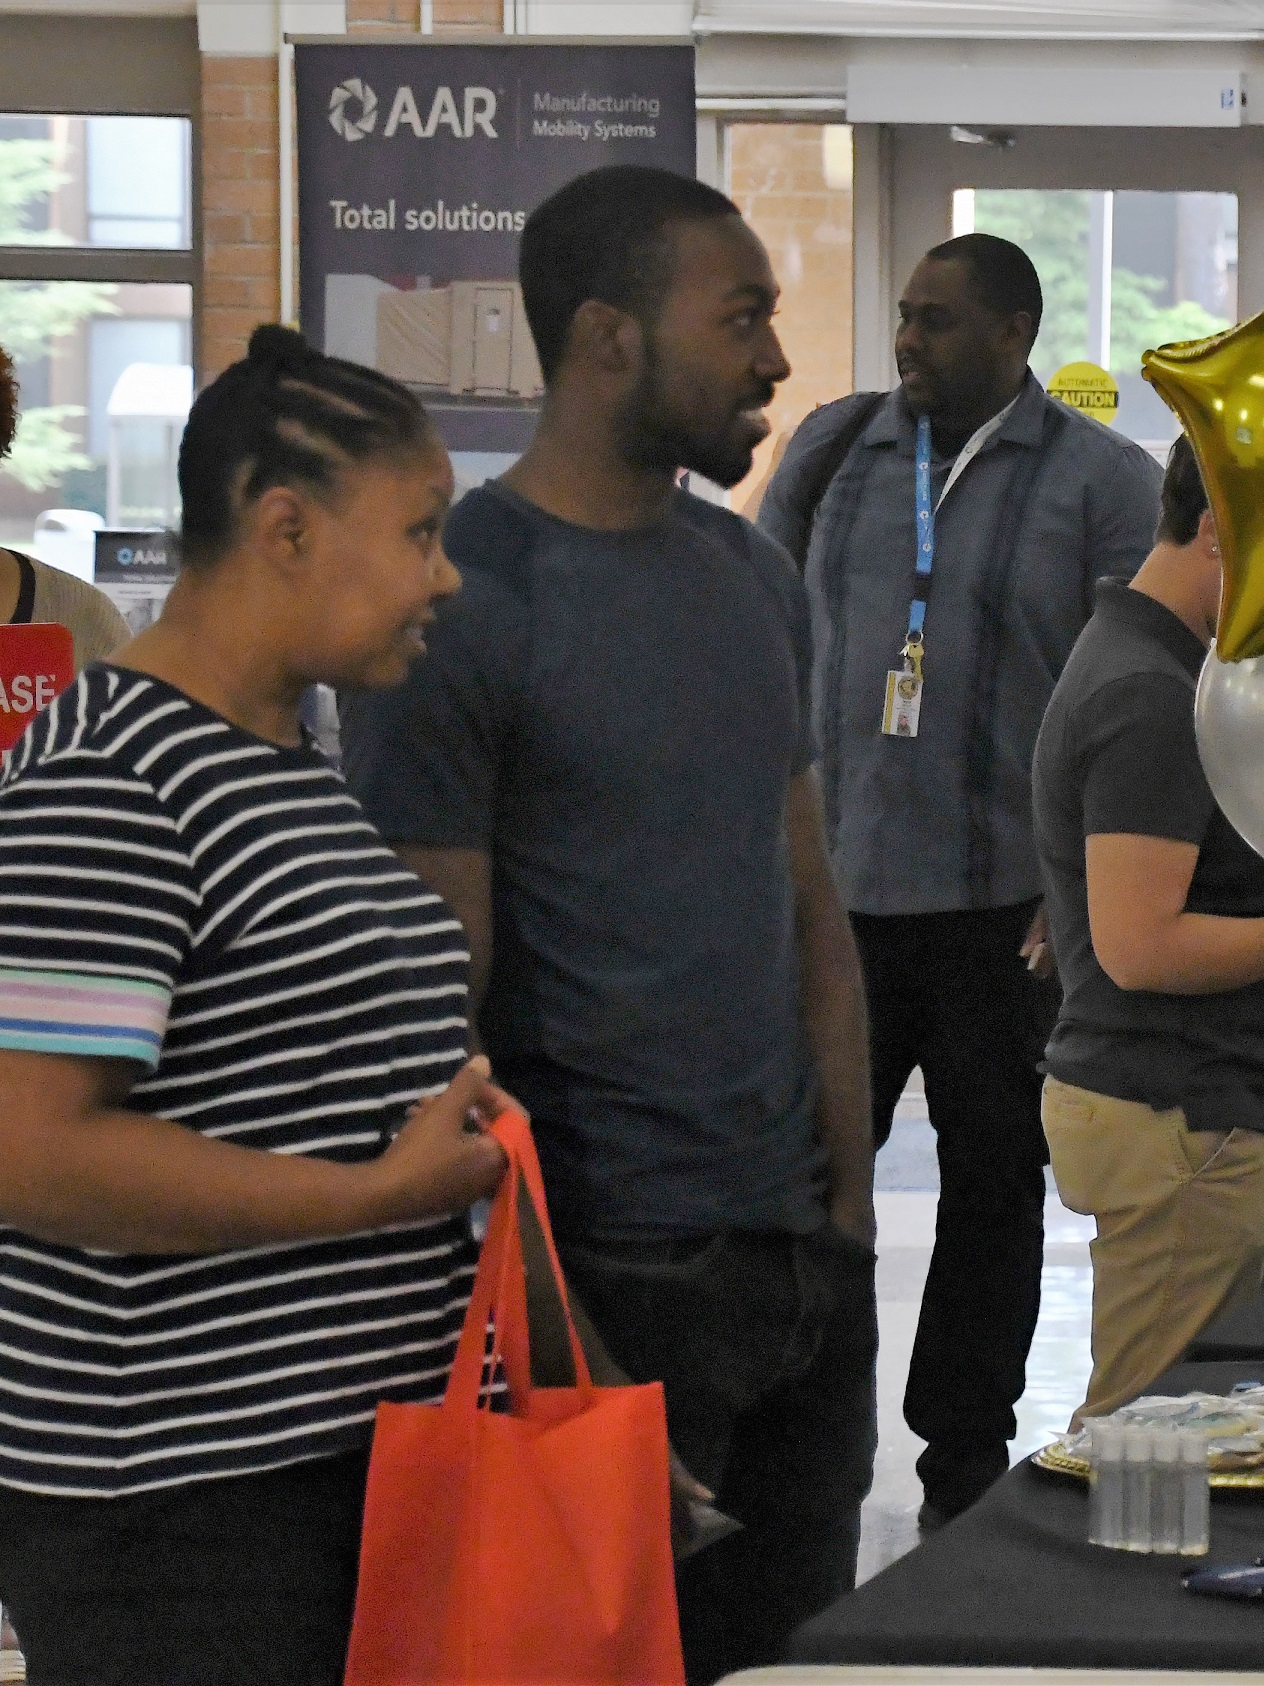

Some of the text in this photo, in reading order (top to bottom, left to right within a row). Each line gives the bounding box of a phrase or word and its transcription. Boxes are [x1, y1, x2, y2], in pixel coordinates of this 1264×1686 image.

[384, 86, 498, 138] AAR
[533, 92, 660, 117] Manufacturing
[533, 120, 657, 141] Mobility Systems
[330, 200, 525, 231] Total solutions
